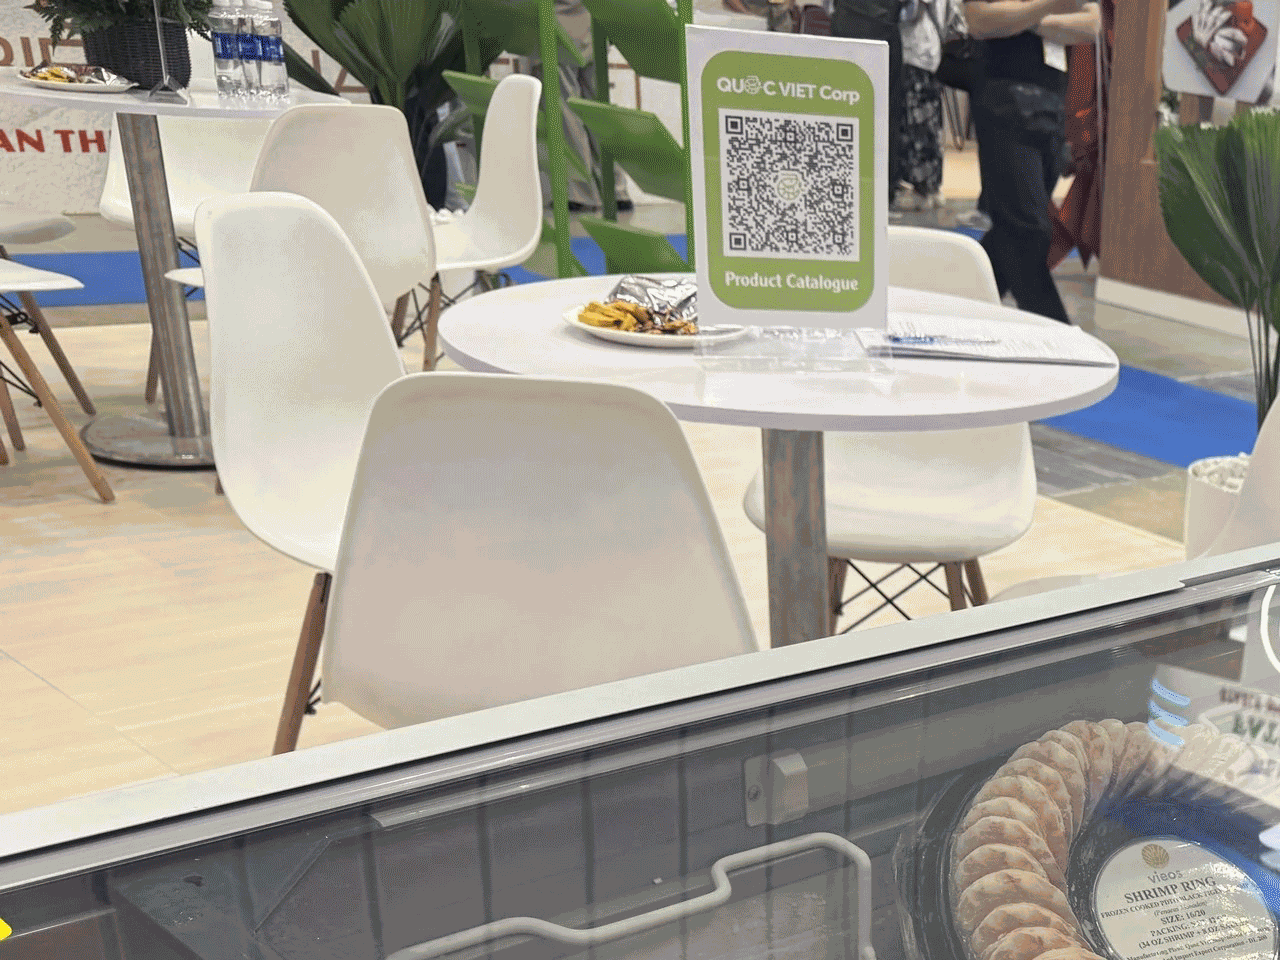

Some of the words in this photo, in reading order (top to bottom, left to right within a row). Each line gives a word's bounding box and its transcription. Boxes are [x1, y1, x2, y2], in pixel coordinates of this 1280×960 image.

[779, 81, 817, 99] VIET
[819, 85, 861, 105] Corp
[53, 129, 111, 153] TH
[724, 270, 783, 289] Product
[786, 273, 860, 292] Catalogue
[1148, 869, 1183, 884] vieos
[1124, 884, 1178, 904] SHRIMP
[1184, 876, 1216, 892] RING
[1101, 907, 1129, 919] FROZEN
[1130, 902, 1159, 914] COOKED
[1161, 914, 1184, 925] SIZE:
[1186, 909, 1206, 921] 16/20
[1150, 922, 1190, 937] PACKING:
[1152, 937, 1164, 948] OZ
[1164, 931, 1194, 945] SHRIMP
